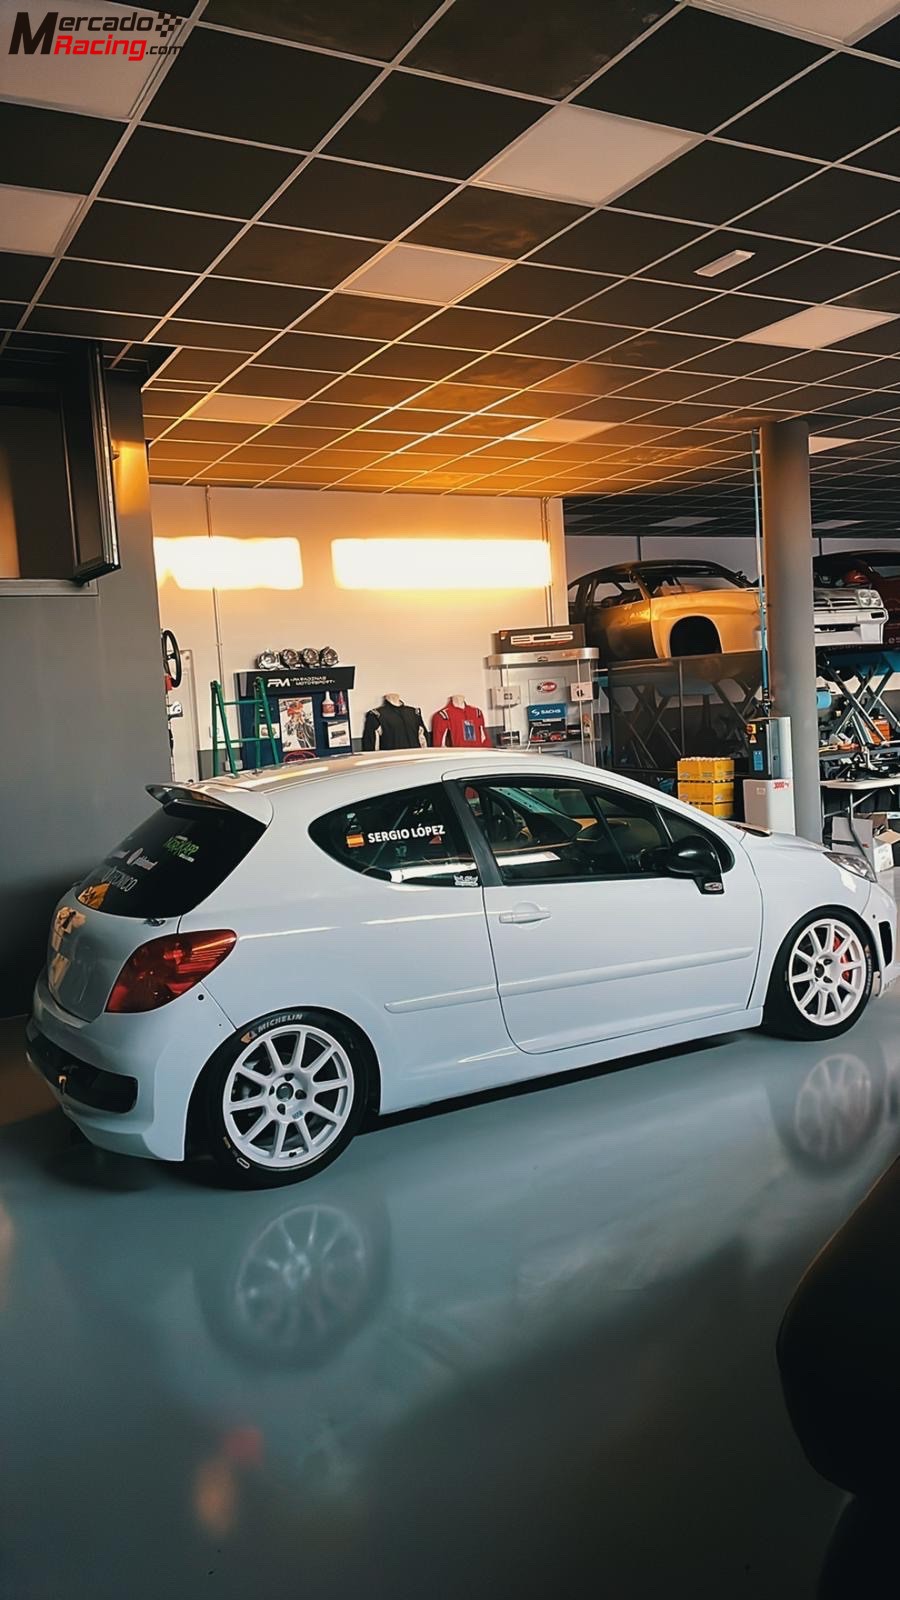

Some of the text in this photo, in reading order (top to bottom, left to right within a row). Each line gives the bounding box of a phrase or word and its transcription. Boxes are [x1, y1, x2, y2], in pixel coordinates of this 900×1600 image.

[367, 823, 446, 843] SERGIO LÓPEZ
[257, 1013, 303, 1033] MICHELIN
